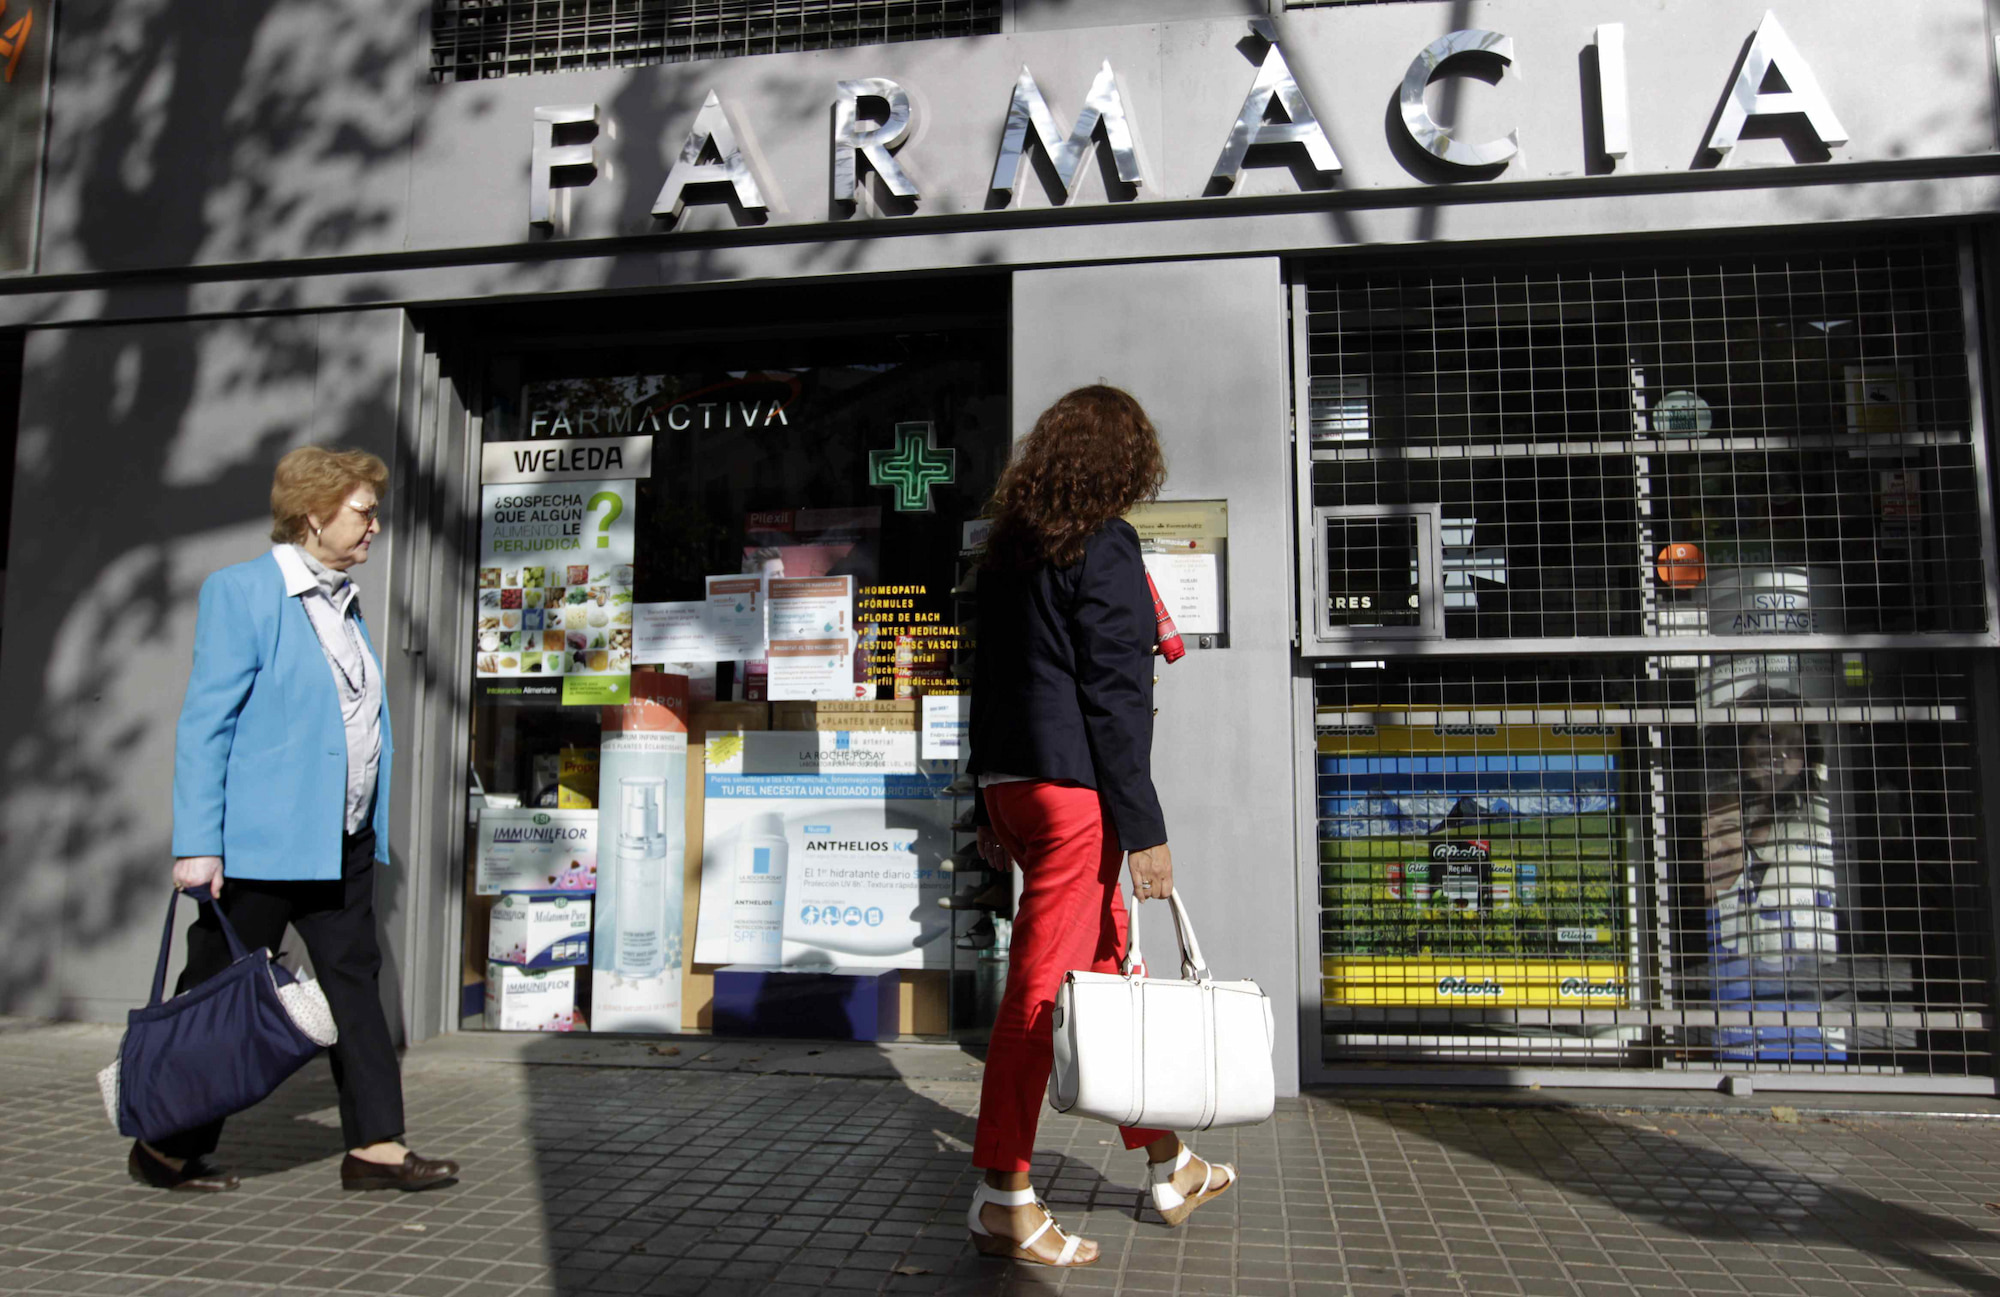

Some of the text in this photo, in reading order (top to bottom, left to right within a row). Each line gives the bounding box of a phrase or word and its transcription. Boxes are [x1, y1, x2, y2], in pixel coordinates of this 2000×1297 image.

[529, 8, 1850, 227] FARMÀCIA
[531, 399, 789, 437] FARMACTIVA
[514, 446, 623, 473] WELEDA
[495, 494, 583, 510] ¿SOSPECHA
[494, 506, 582, 524] QUE ALGÚN
[751, 512, 789, 525] Pilexil
[493, 523, 581, 538] ALIMENTO LE
[493, 537, 581, 552] PERJUDICA
[864, 585, 927, 595] HOMEOPATIA
[864, 598, 914, 608] FÓRMULES
[1756, 595, 1797, 610] SVR
[864, 613, 941, 622] FLORS DE BACH
[1732, 612, 1819, 629] ANTI-AGE
[864, 626, 905, 636] PLANTES
[864, 640, 897, 650] ESTUDI
[523, 686, 557, 694] Alimentaria
[799, 751, 886, 760] LA ROCHE-POSAY
[711, 775, 732, 783] Pieles
[721, 785, 735, 796] TU
[736, 785, 757, 796] PIEL
[759, 785, 807, 796] NECESITA
[808, 785, 823, 796] UN
[825, 785, 869, 797] CUIDADO
[871, 785, 905, 796] DIARIO
[493, 827, 588, 841] IMMUNILFLOR
[806, 841, 889, 851] ANTHELIOS
[1432, 844, 1487, 860] Ricola
[804, 868, 814, 878] El
[830, 867, 880, 879] hidratante
[883, 868, 911, 879] diario
[913, 869, 933, 879] SPF
[1407, 862, 1430, 873] Rico
[1489, 863, 1513, 873] icola
[1448, 865, 1472, 874] Regaliz
[803, 879, 840, 888] Protección
[841, 880, 849, 888] UV
[867, 880, 898, 889] Textura
[899, 881, 918, 890] rápida
[734, 930, 758, 943] SPF
[1438, 977, 1626, 997] Ricola Ricola
